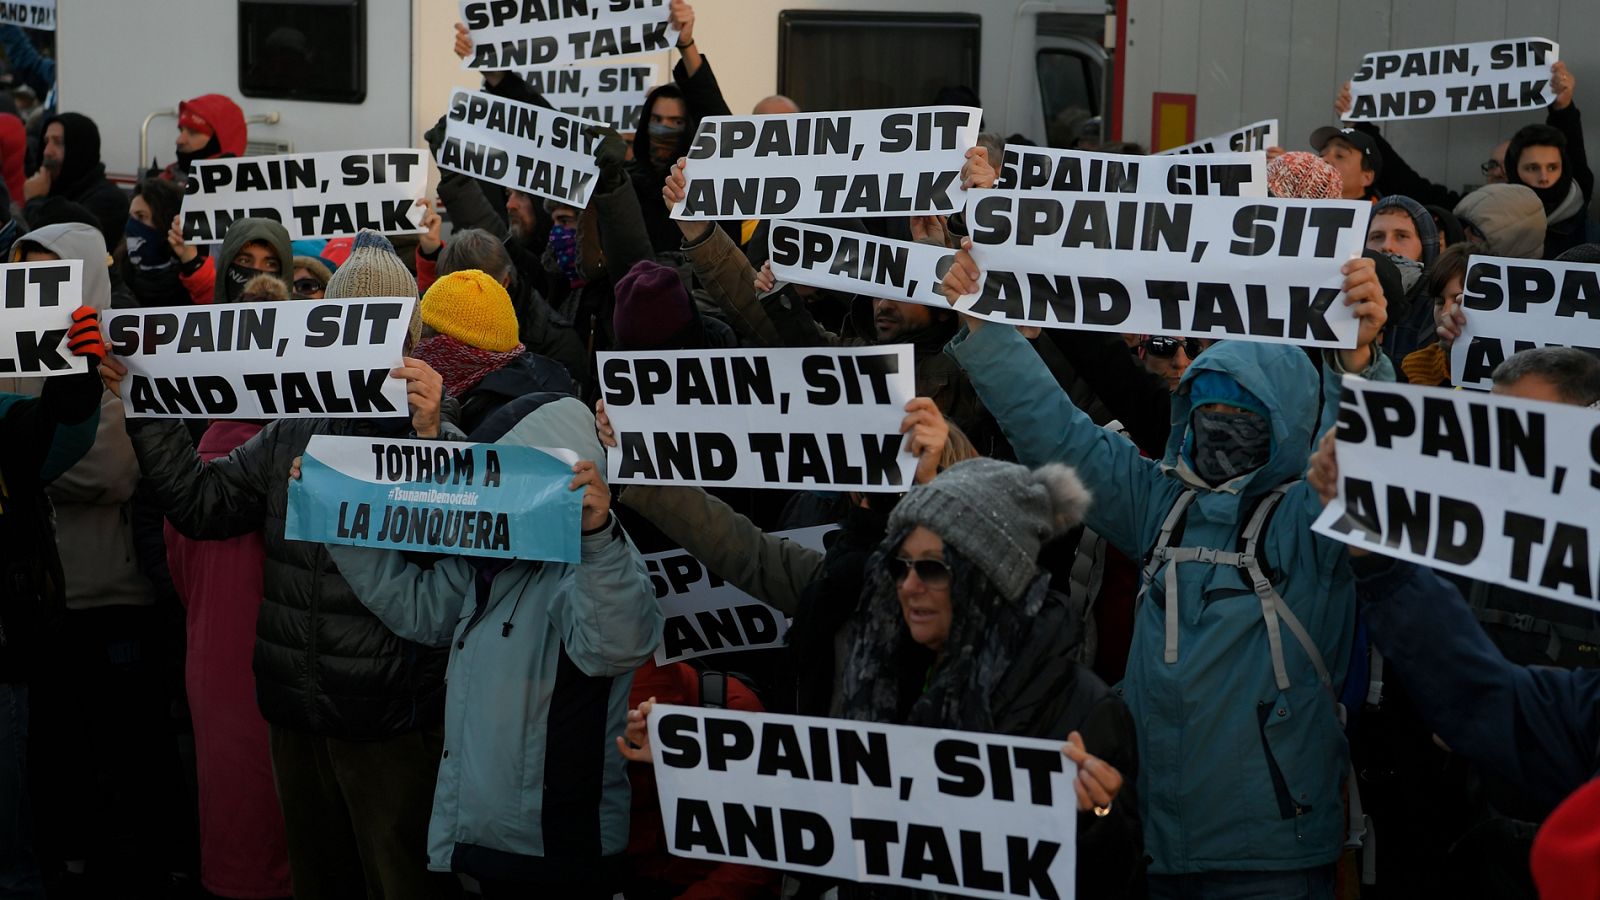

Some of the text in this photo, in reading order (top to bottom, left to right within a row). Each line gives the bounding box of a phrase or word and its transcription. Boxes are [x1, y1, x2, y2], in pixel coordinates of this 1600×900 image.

[465, 0, 598, 31] SPAIN,
[467, 22, 670, 68] AND TALK
[1353, 41, 1553, 82] SPAIN, SIT
[598, 67, 651, 92] SIT
[1350, 80, 1548, 118] AND TALK
[449, 92, 544, 148] SPAIN,
[689, 112, 970, 161] SPAIN, SIT
[184, 154, 419, 195] SPAIN, SIT
[441, 138, 593, 205] AND TALK
[681, 171, 960, 216] AND TALK
[293, 200, 418, 236] TALK
[973, 196, 1356, 263] SPAIN, SIT
[772, 226, 919, 298] SPAIN,
[109, 303, 402, 358] SPAIN, SIT
[969, 270, 1131, 326] AND
[1146, 279, 1342, 342] TALK
[130, 368, 398, 415] AND TALK
[603, 353, 899, 414] SPAIN, SIT
[618, 431, 903, 486] AND TALK
[1337, 380, 1567, 495] SPAIN,
[371, 443, 501, 488] TOTHOM A
[337, 501, 511, 551] LA JONQUERA
[1330, 476, 1600, 600] AND TA
[663, 604, 778, 659] AND
[658, 713, 1064, 806] SPAIN, SIT
[674, 797, 1061, 900] AND TALK
